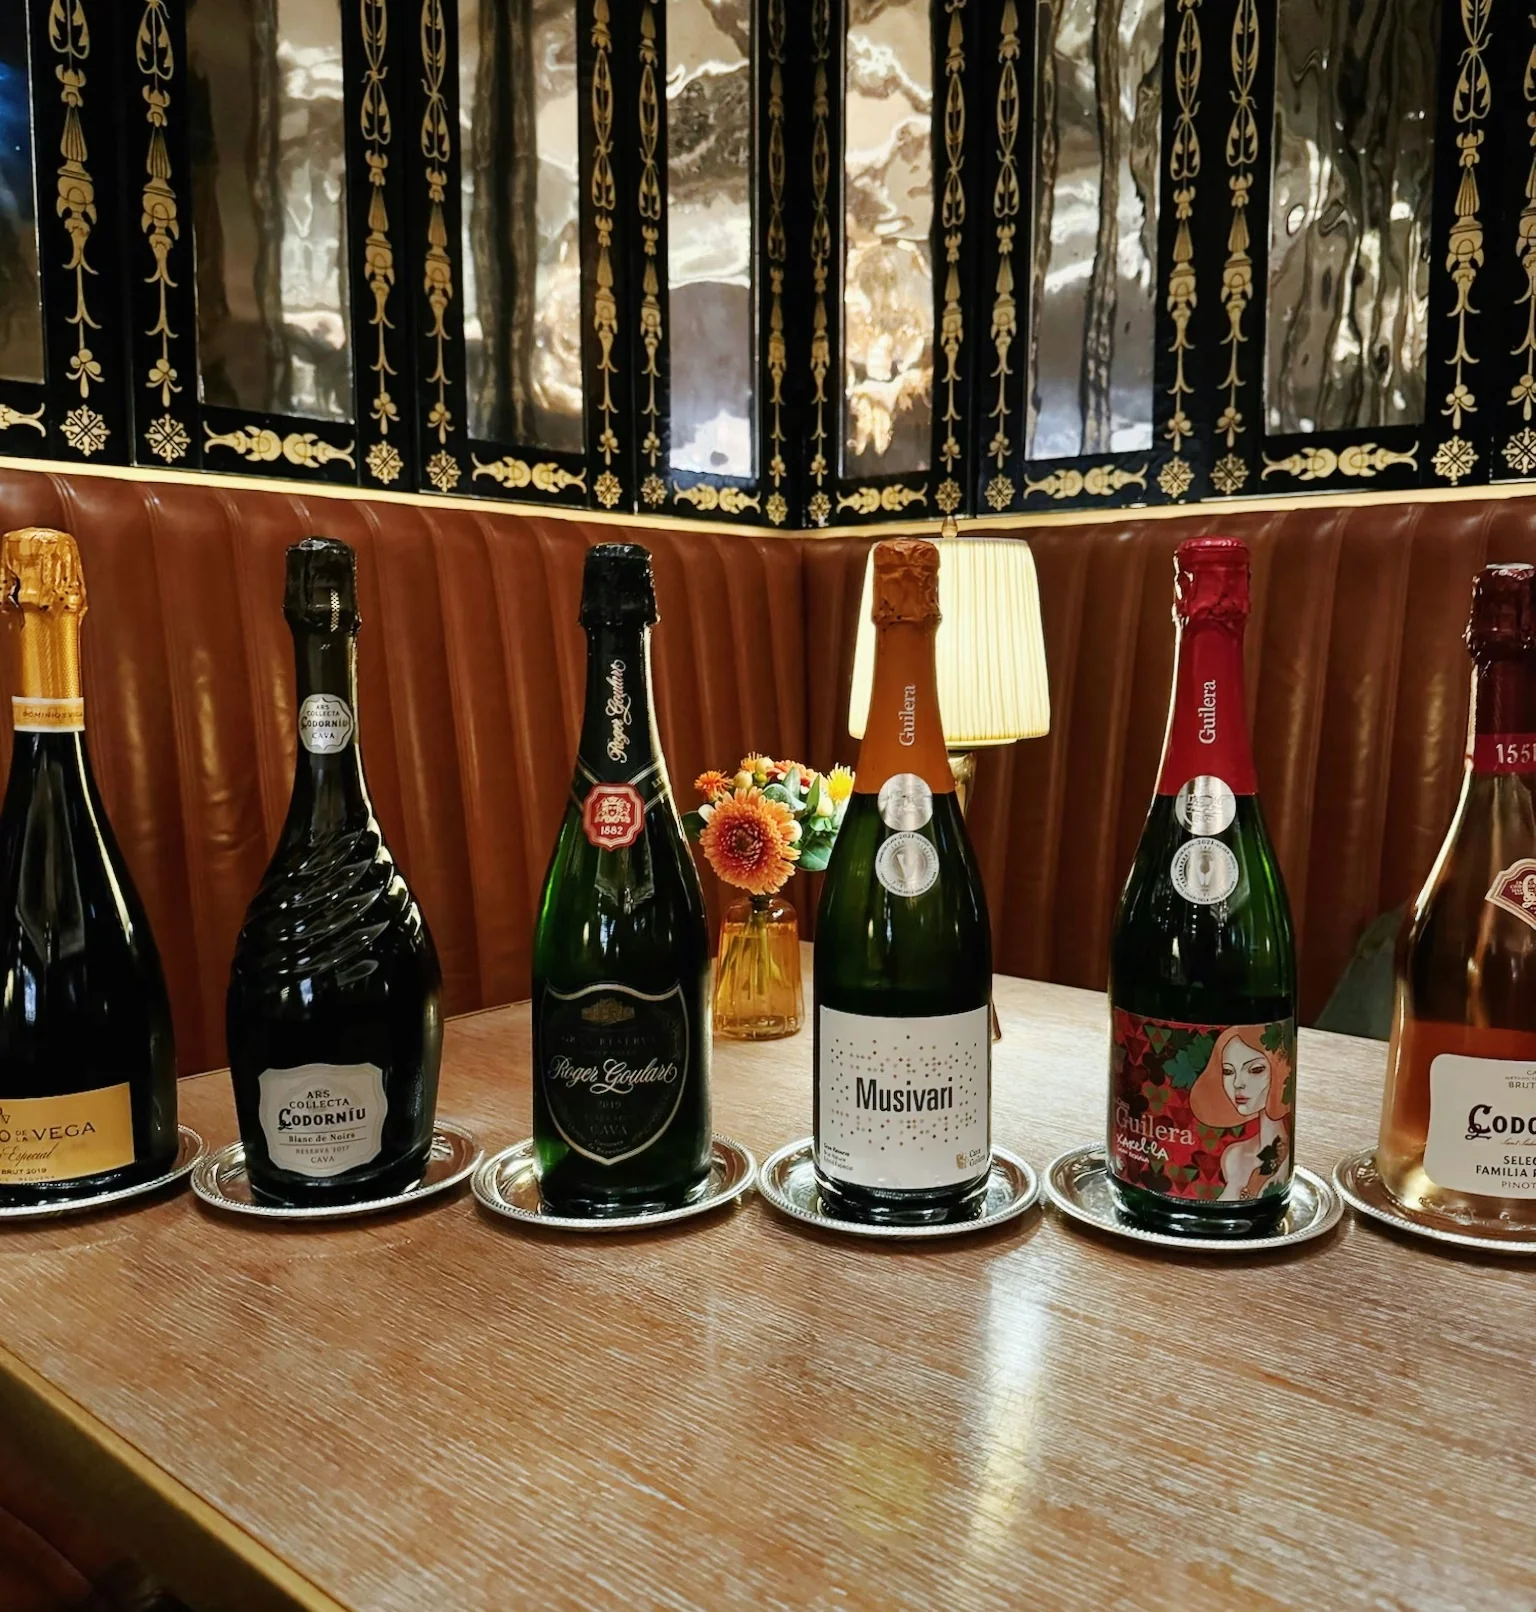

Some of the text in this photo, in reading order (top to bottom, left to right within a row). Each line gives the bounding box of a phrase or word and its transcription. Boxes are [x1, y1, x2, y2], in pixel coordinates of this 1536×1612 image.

[899, 684, 916, 746] Guilera
[1198, 679, 1216, 744] Guilera
[601, 825, 624, 836] 1882
[548, 1055, 678, 1094] Roger Goulart
[306, 1089, 330, 1099] ARS
[856, 1077, 953, 1112] Musivari
[289, 1098, 350, 1110] COLLECTA
[32, 1122, 96, 1141] VEGA
[1116, 1107, 1196, 1146] Guilera
[288, 1132, 356, 1143] Blanc de Noirs
[26, 1167, 47, 1175] 2019
[1476, 1164, 1528, 1177] FAMILIA
